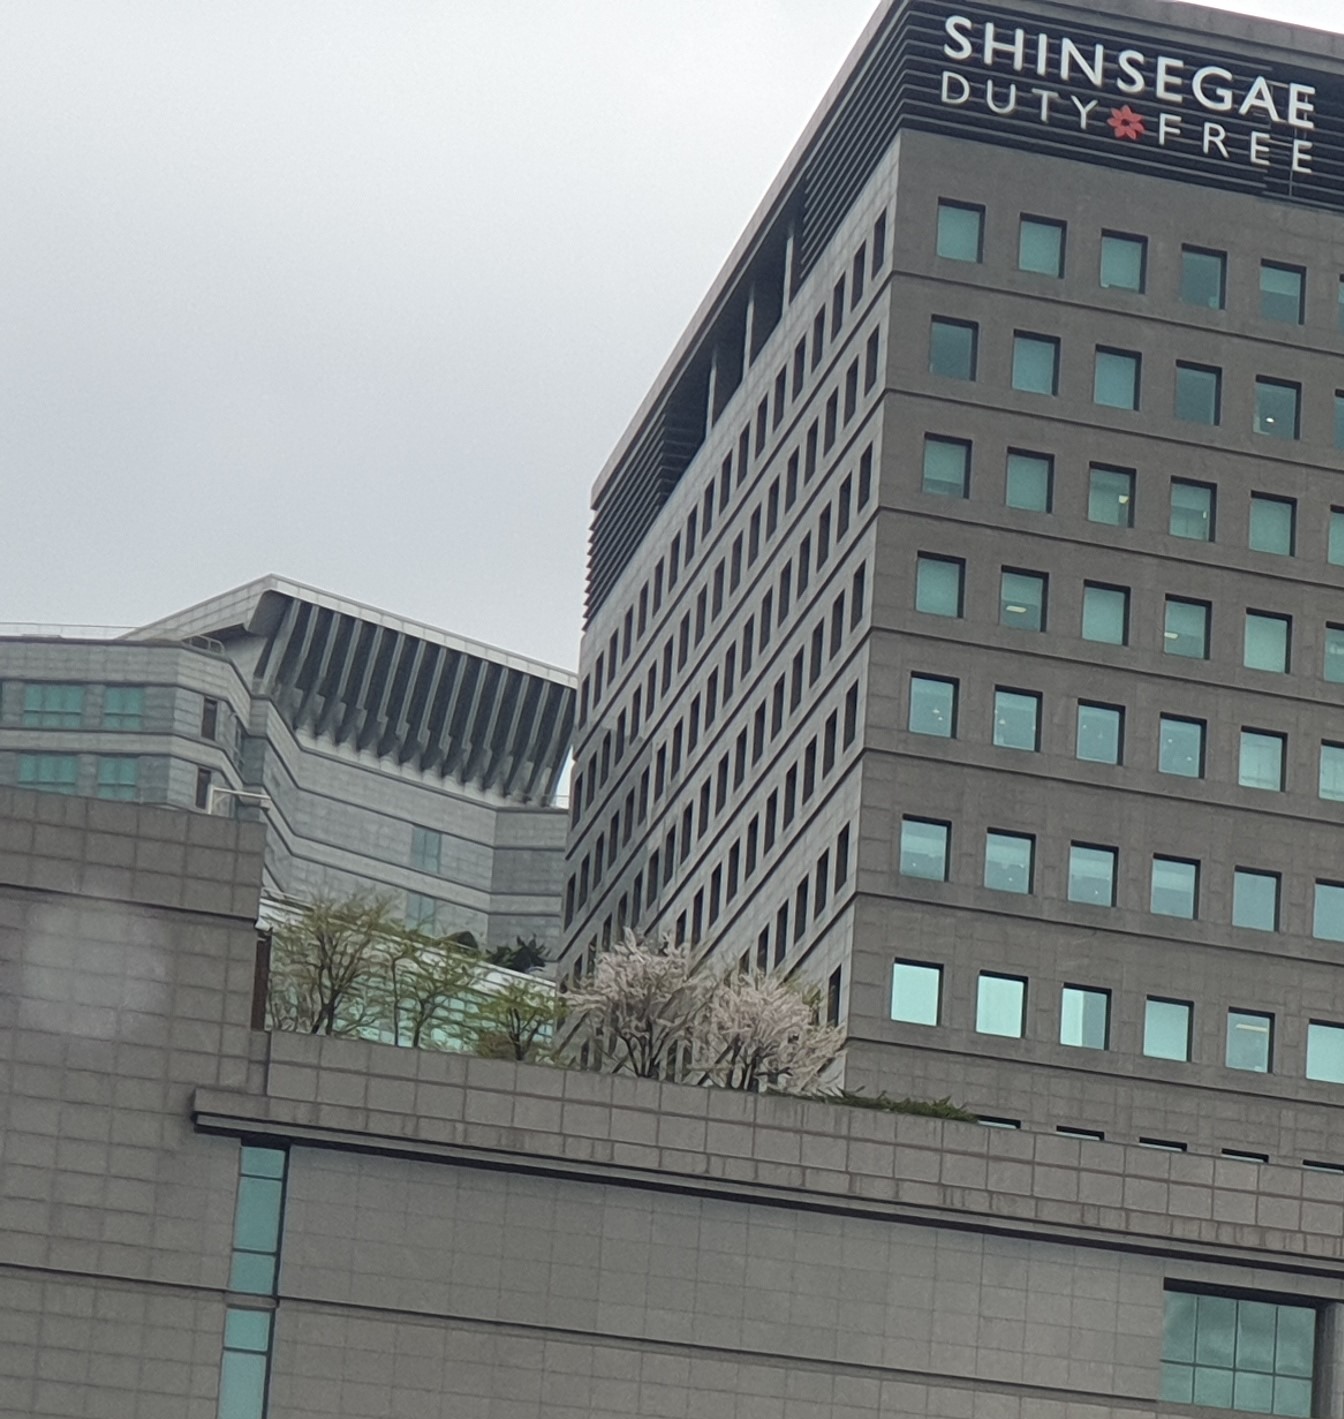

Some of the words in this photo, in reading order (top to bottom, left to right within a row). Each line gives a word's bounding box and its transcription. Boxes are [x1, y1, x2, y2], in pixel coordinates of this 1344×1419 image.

[940, 70, 1099, 130] DUTY
[1158, 112, 1313, 174] FREE
[941, 14, 1317, 130] SHINSEGAE
